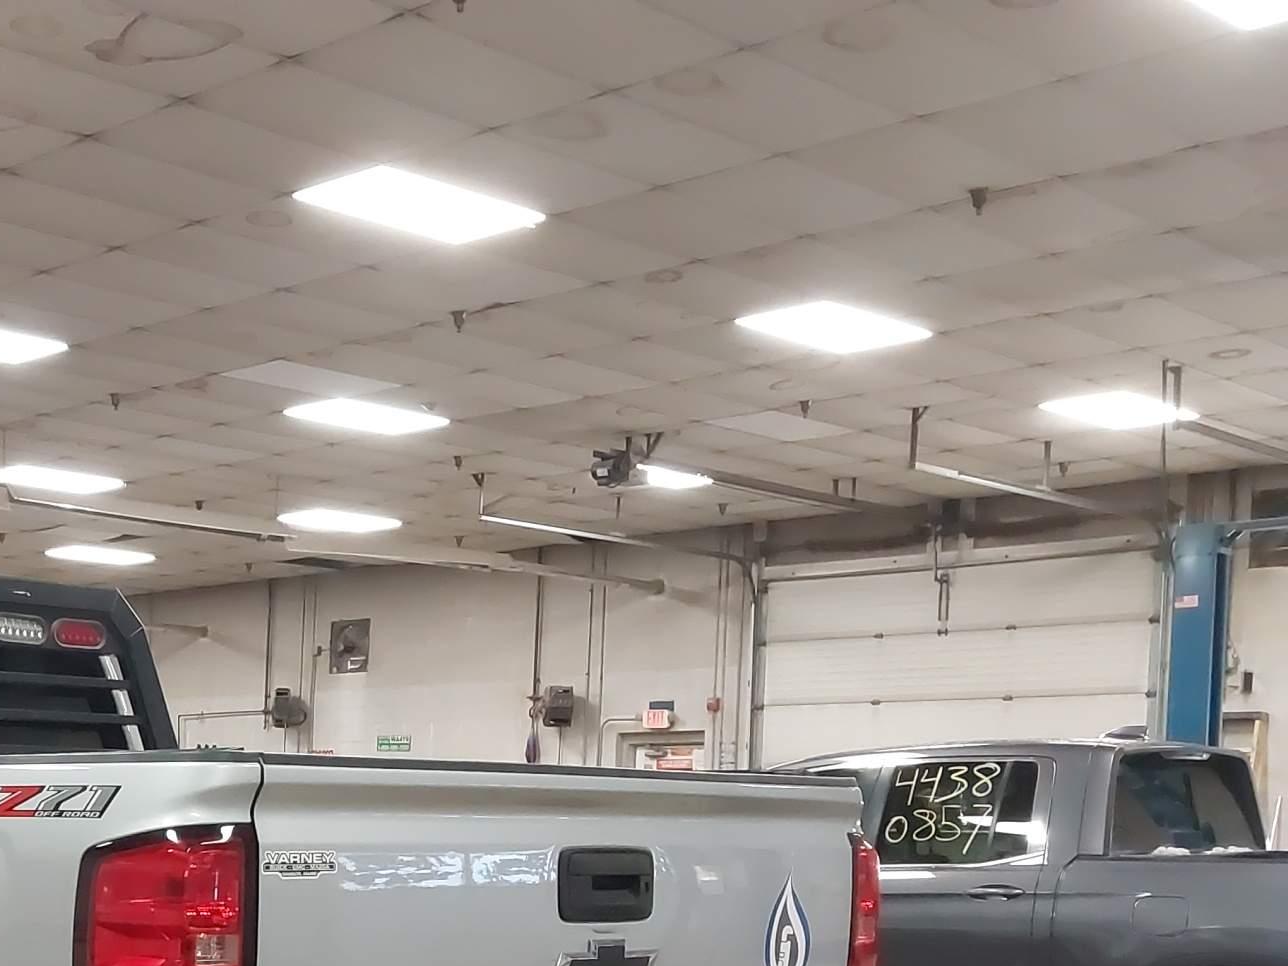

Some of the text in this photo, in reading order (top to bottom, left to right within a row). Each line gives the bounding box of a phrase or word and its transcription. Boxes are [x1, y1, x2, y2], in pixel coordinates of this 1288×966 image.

[647, 710, 666, 727] EXIT
[895, 762, 1001, 806] 4438
[61, 810, 101, 818] ROAD
[885, 804, 993, 855] 0857
[265, 852, 334, 864] VARNEY
